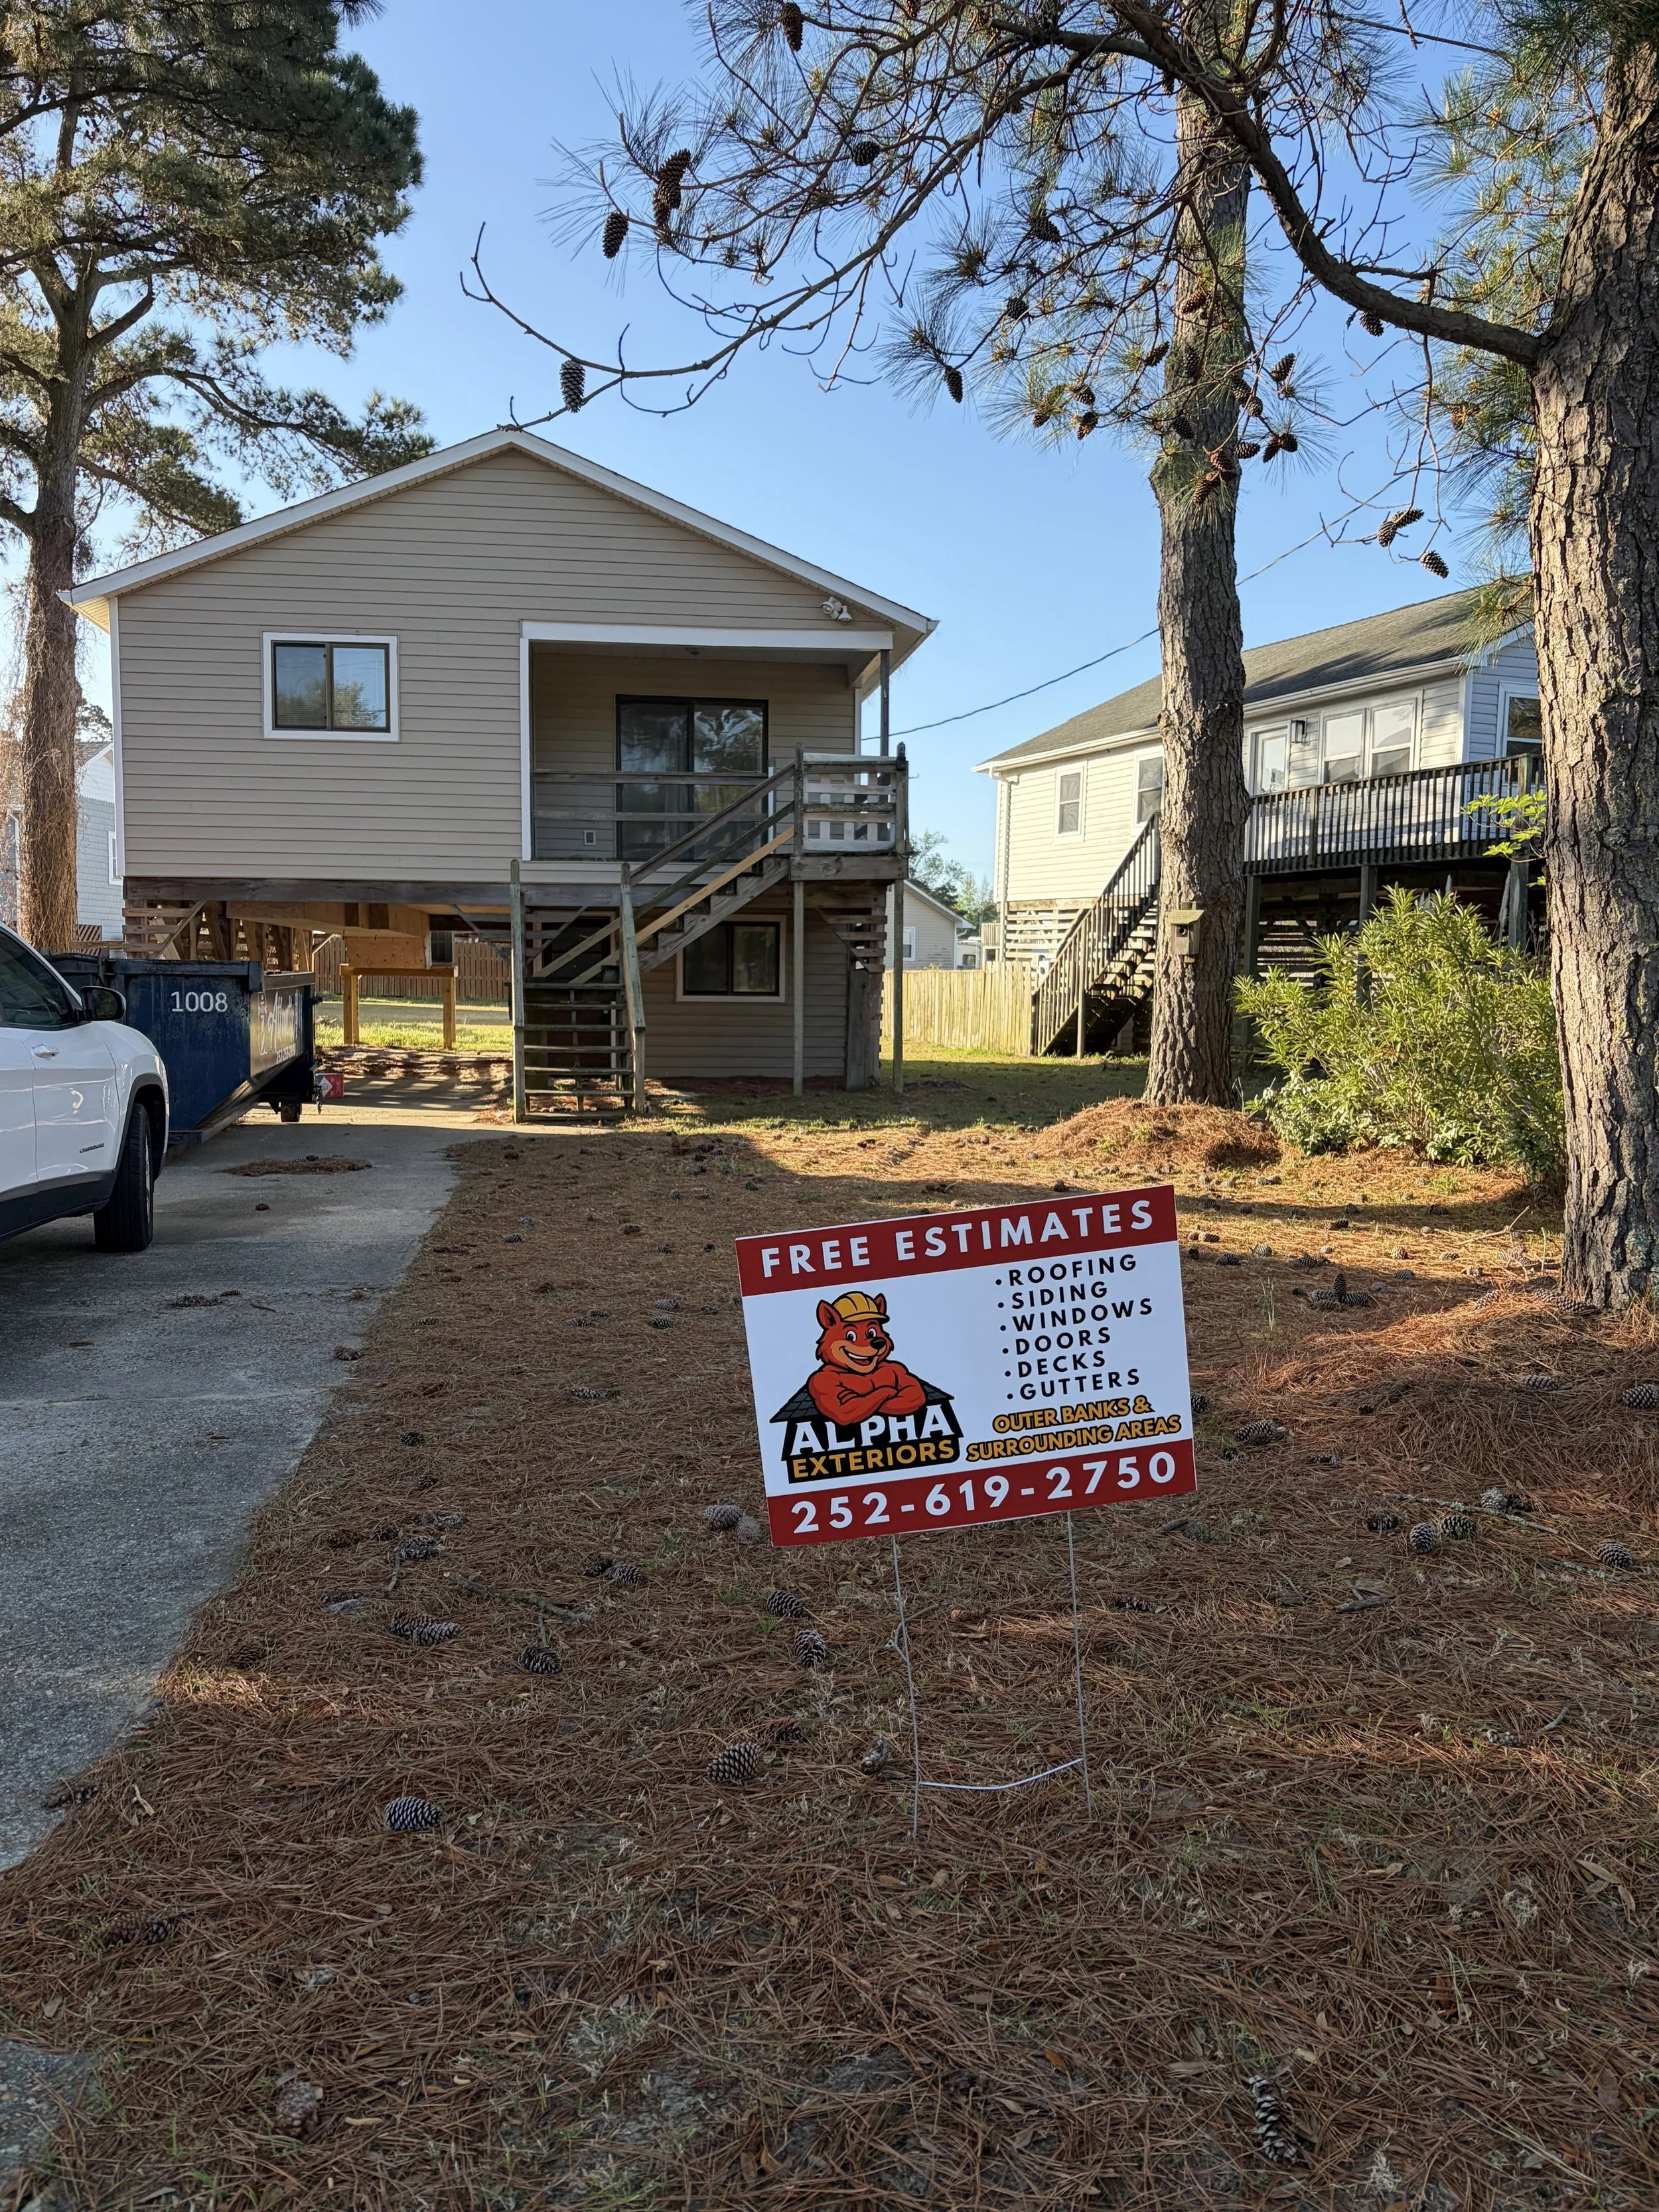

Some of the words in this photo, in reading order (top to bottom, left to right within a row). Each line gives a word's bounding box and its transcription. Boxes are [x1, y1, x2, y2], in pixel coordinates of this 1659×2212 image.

[171, 991, 228, 1013] 1008
[761, 1236, 870, 1278] FREE
[896, 1200, 1153, 1261] ESTIMATES
[1009, 1254, 1136, 1287] ROOFING
[1011, 1282, 1108, 1309] SIDING
[1012, 1298, 1153, 1332] WINDOWS
[1015, 1327, 1111, 1355] DOORS
[1018, 1351, 1106, 1378] DECKS
[1020, 1368, 1140, 1400] GUTTERS
[790, 1404, 956, 1456] ALPHA
[993, 1408, 1058, 1433] OUTER
[1060, 1398, 1130, 1424] BANKS
[1132, 1395, 1155, 1415] &
[966, 1426, 1114, 1461] SURROUNDING
[1114, 1415, 1181, 1441] AREAS
[792, 1439, 954, 1479] EXTERIORS
[790, 1451, 1175, 1534] 252-619-2750
